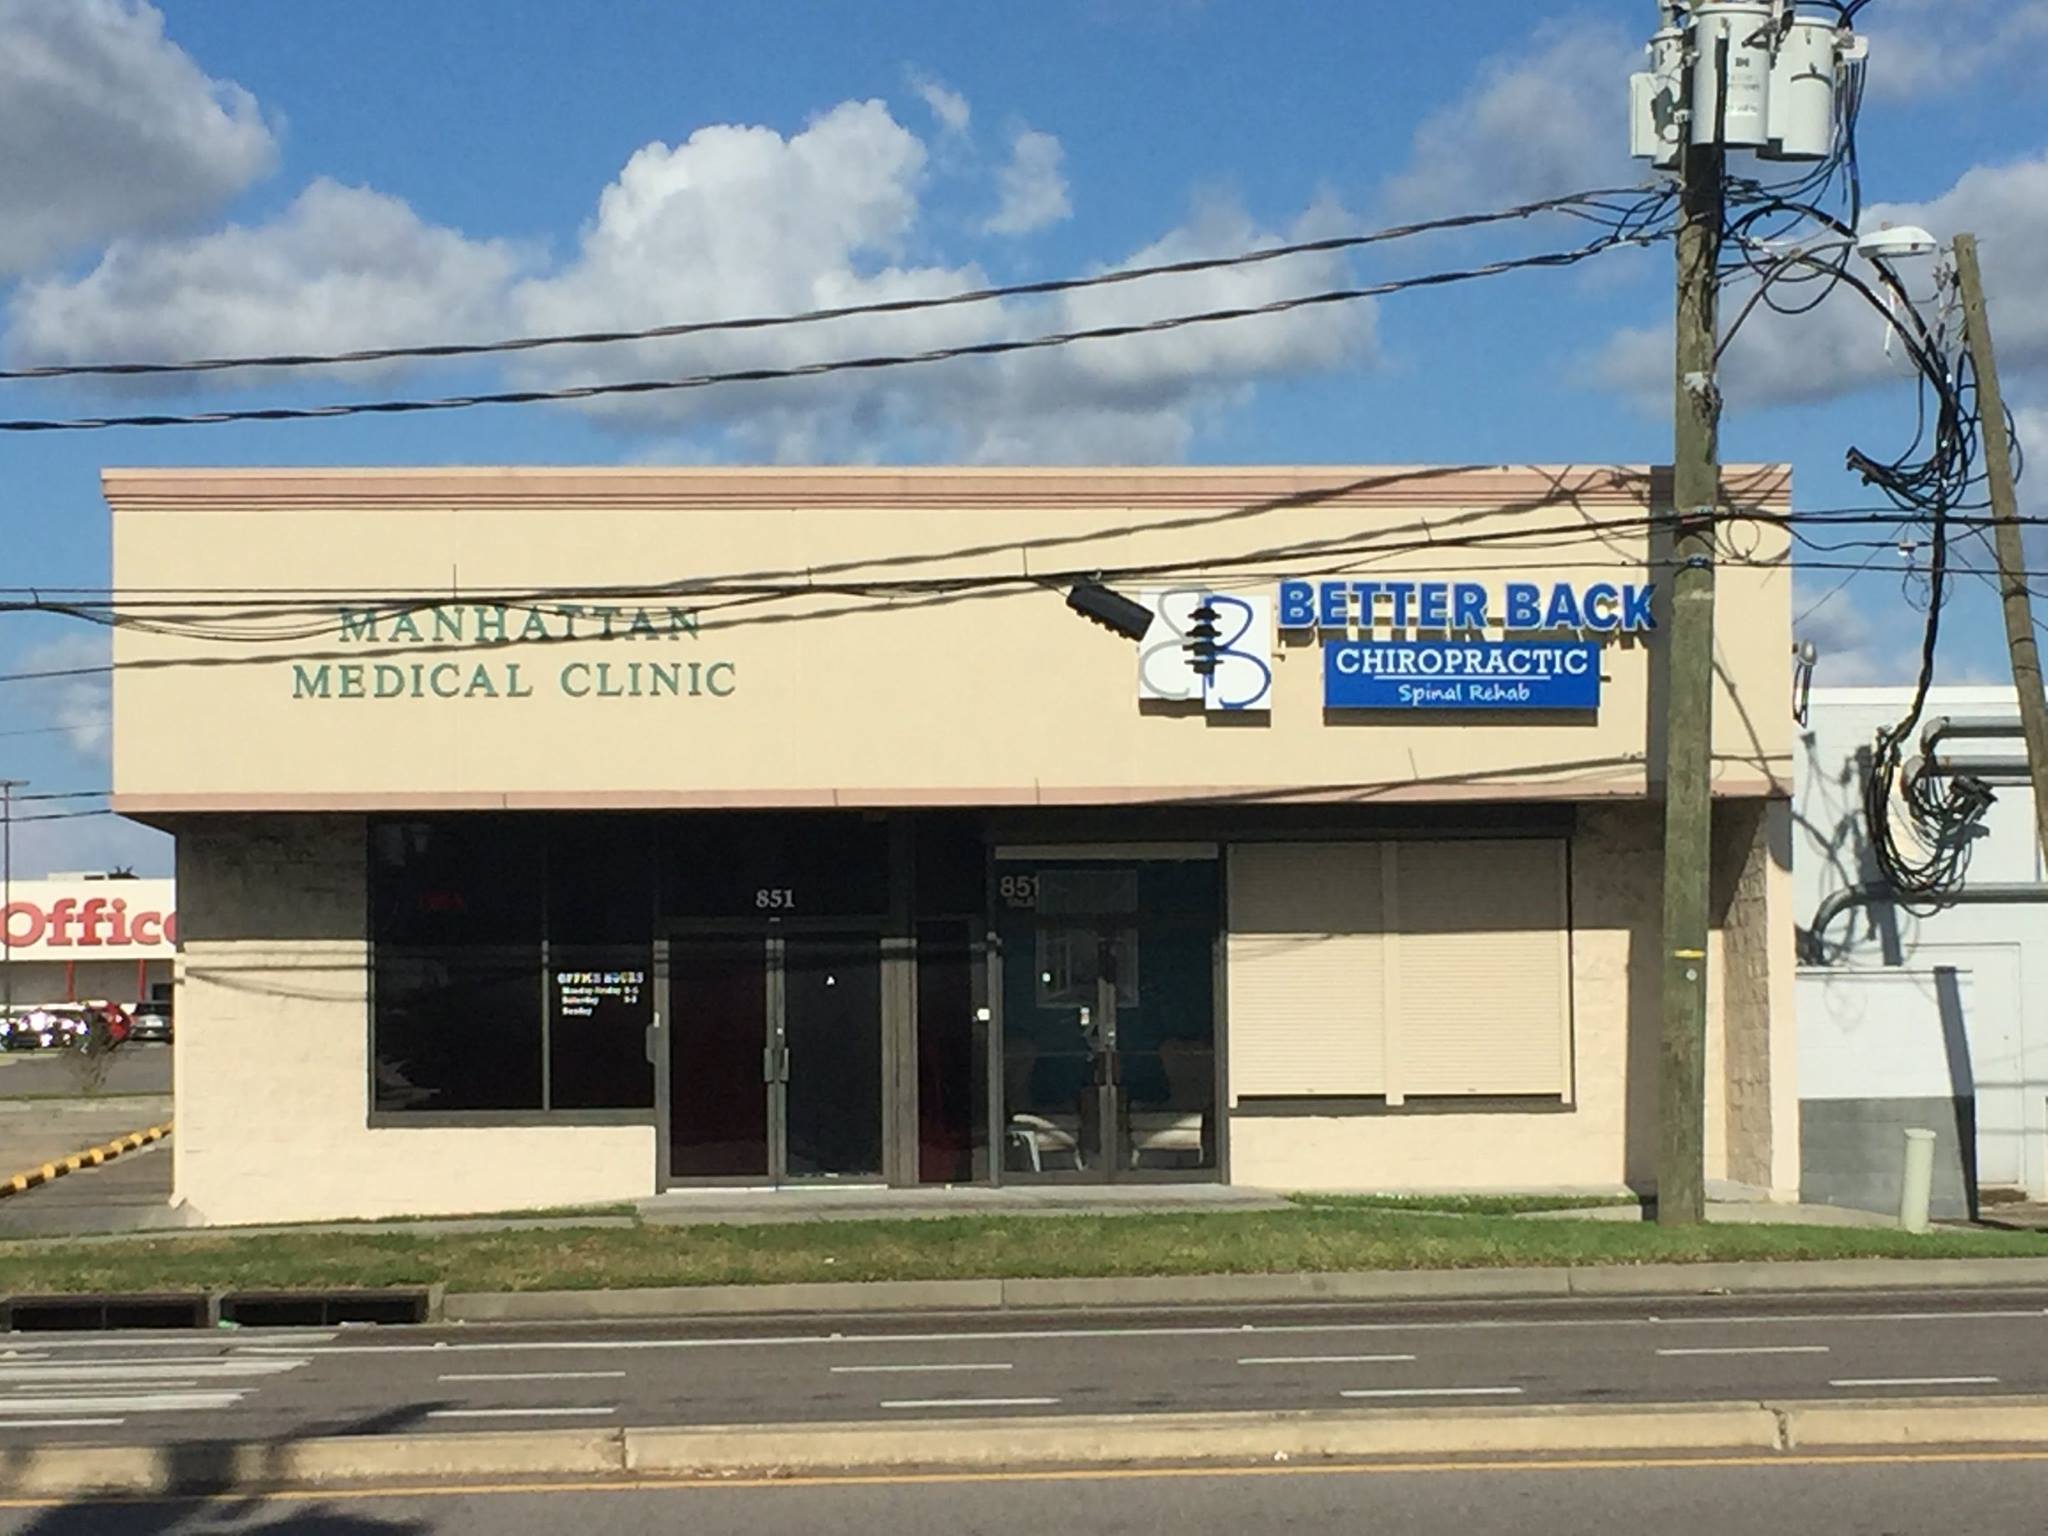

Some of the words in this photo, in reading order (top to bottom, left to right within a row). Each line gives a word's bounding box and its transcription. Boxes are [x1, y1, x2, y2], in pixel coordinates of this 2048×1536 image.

[1278, 580, 1490, 629] BETTER
[1505, 582, 1657, 632] BACK
[339, 605, 699, 642] MANHATTAN
[1336, 648, 1588, 675] CHIROPRACTIC
[292, 663, 533, 698] MEDICAL
[561, 662, 736, 698] CLINIC
[1398, 682, 1462, 707] Spinal
[1469, 682, 1530, 701] Rehab
[755, 888, 796, 909] 851
[1000, 875, 1041, 897] 851
